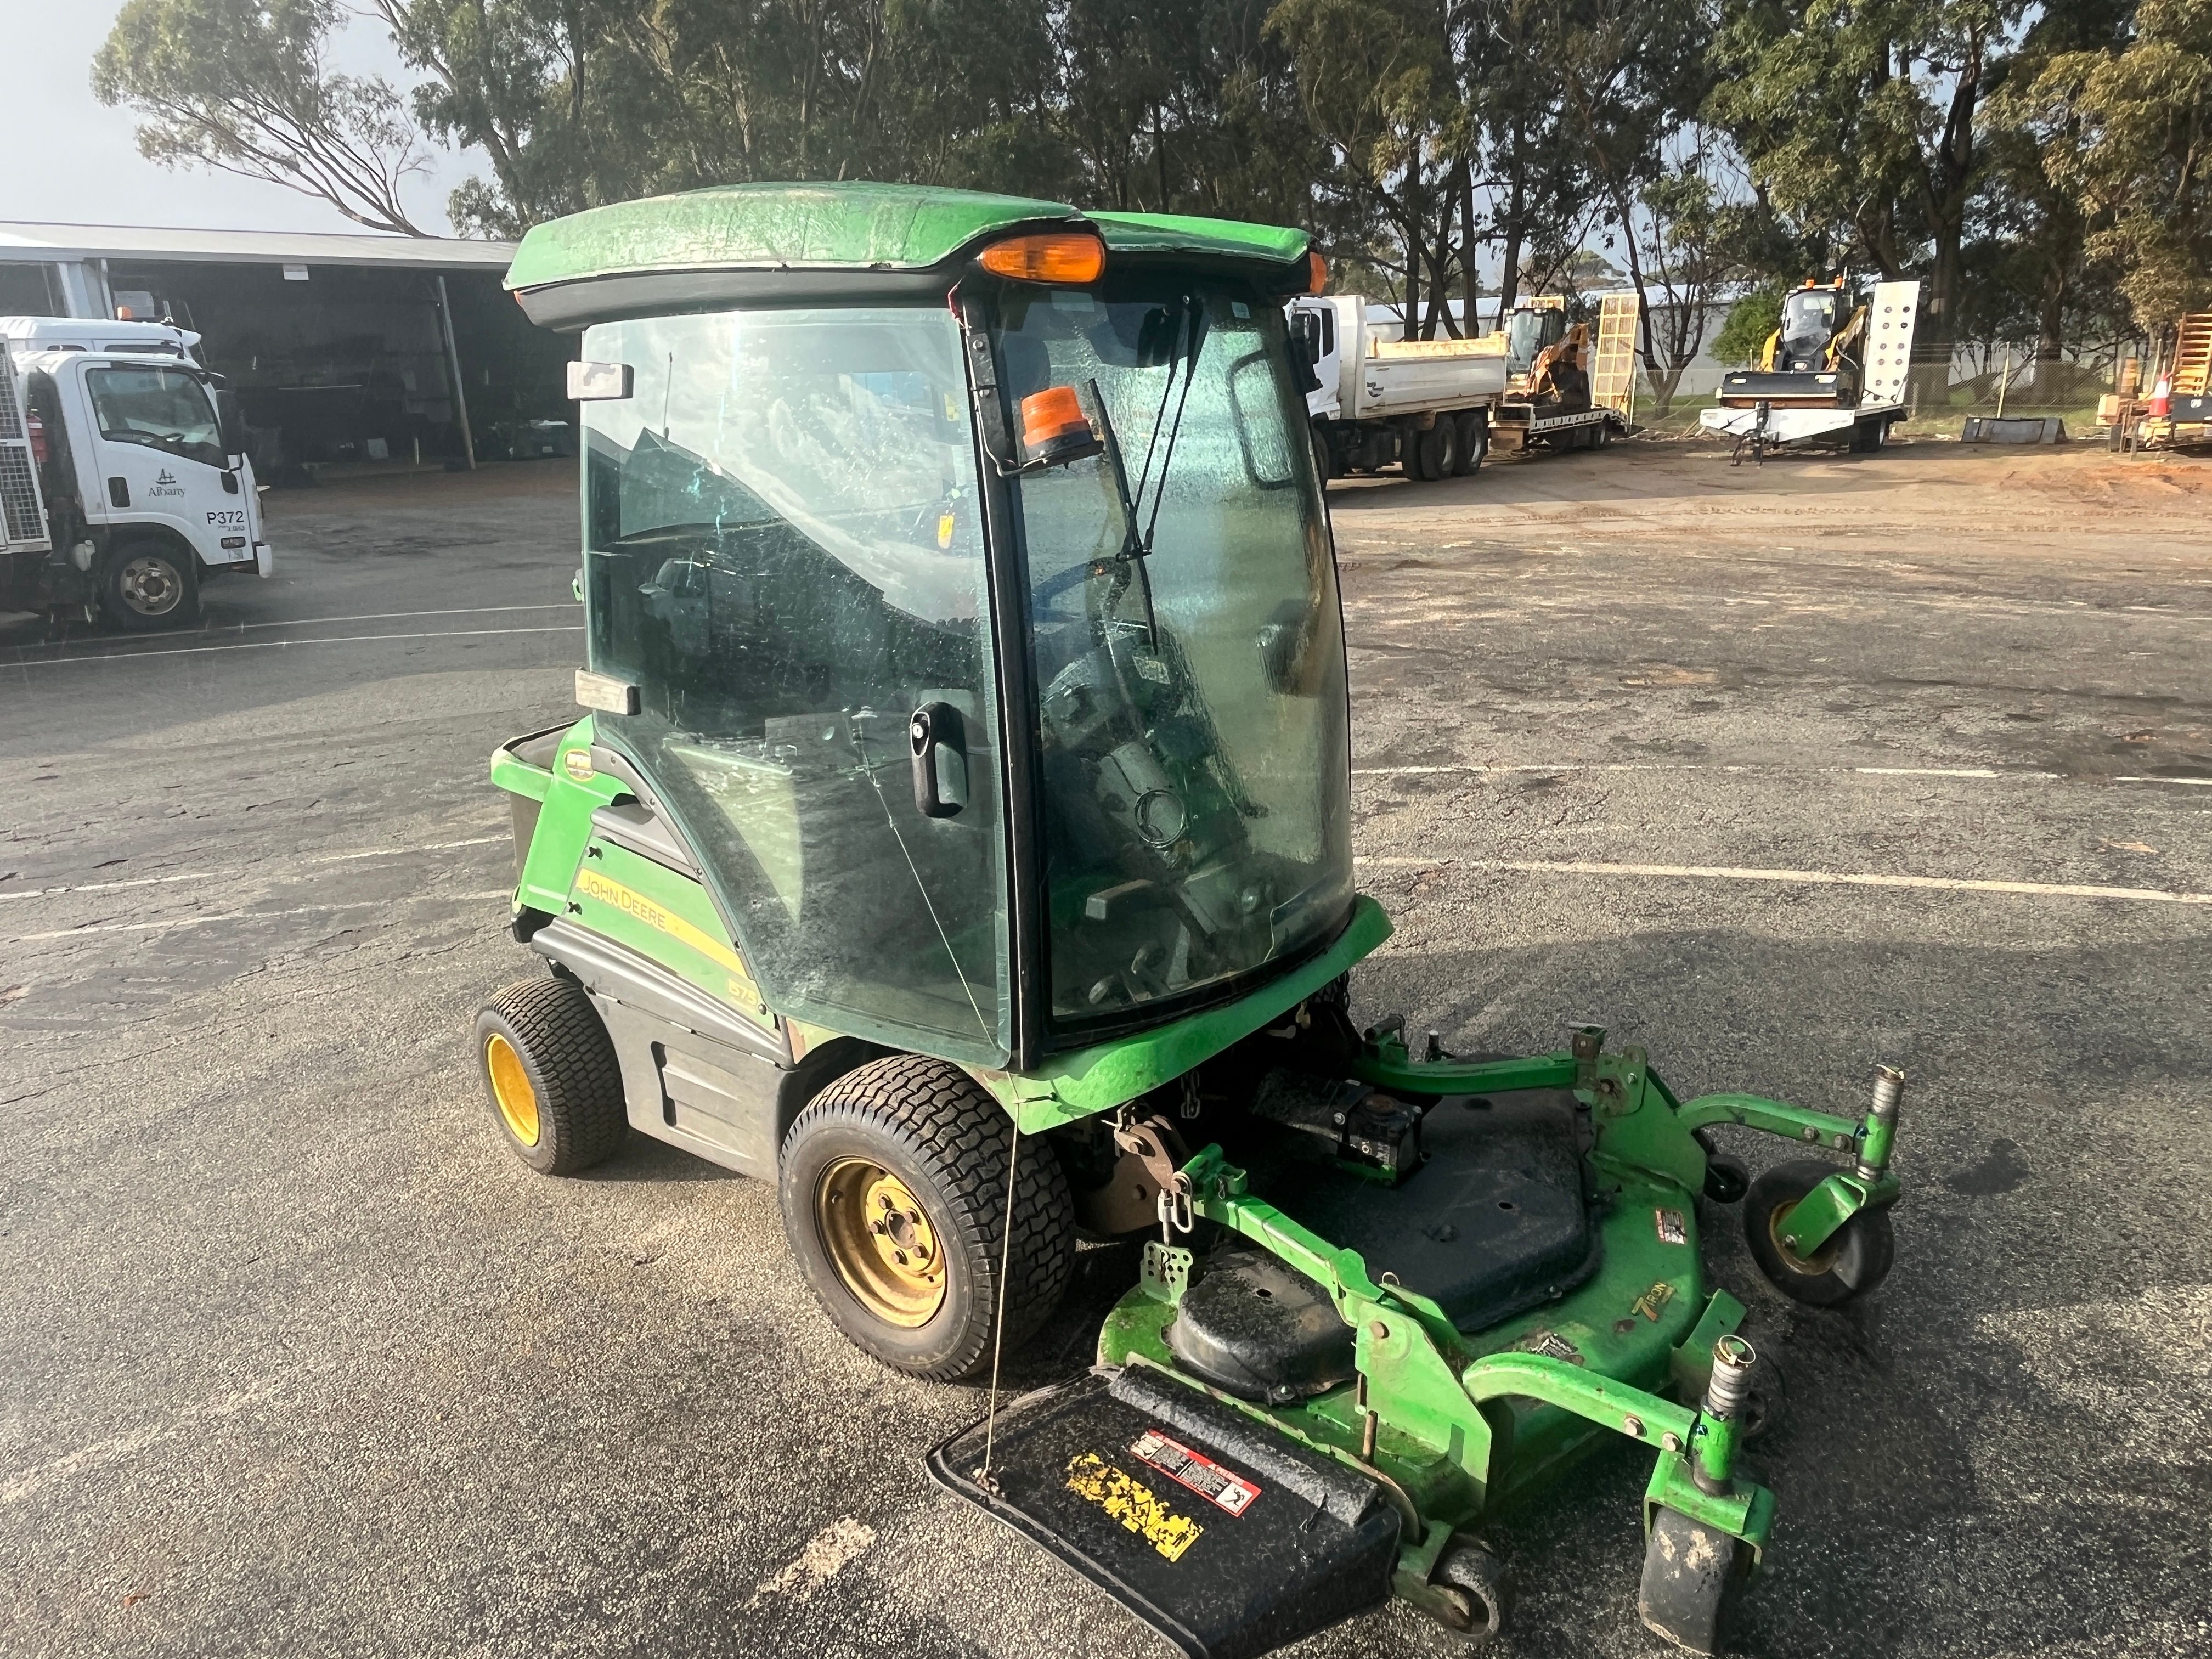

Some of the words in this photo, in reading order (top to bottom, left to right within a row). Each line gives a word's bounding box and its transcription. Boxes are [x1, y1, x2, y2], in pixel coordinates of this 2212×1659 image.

[148, 487, 185, 497] Albany
[206, 511, 244, 524] P372
[584, 876, 618, 905] JOHN
[622, 890, 665, 930] DEERE
